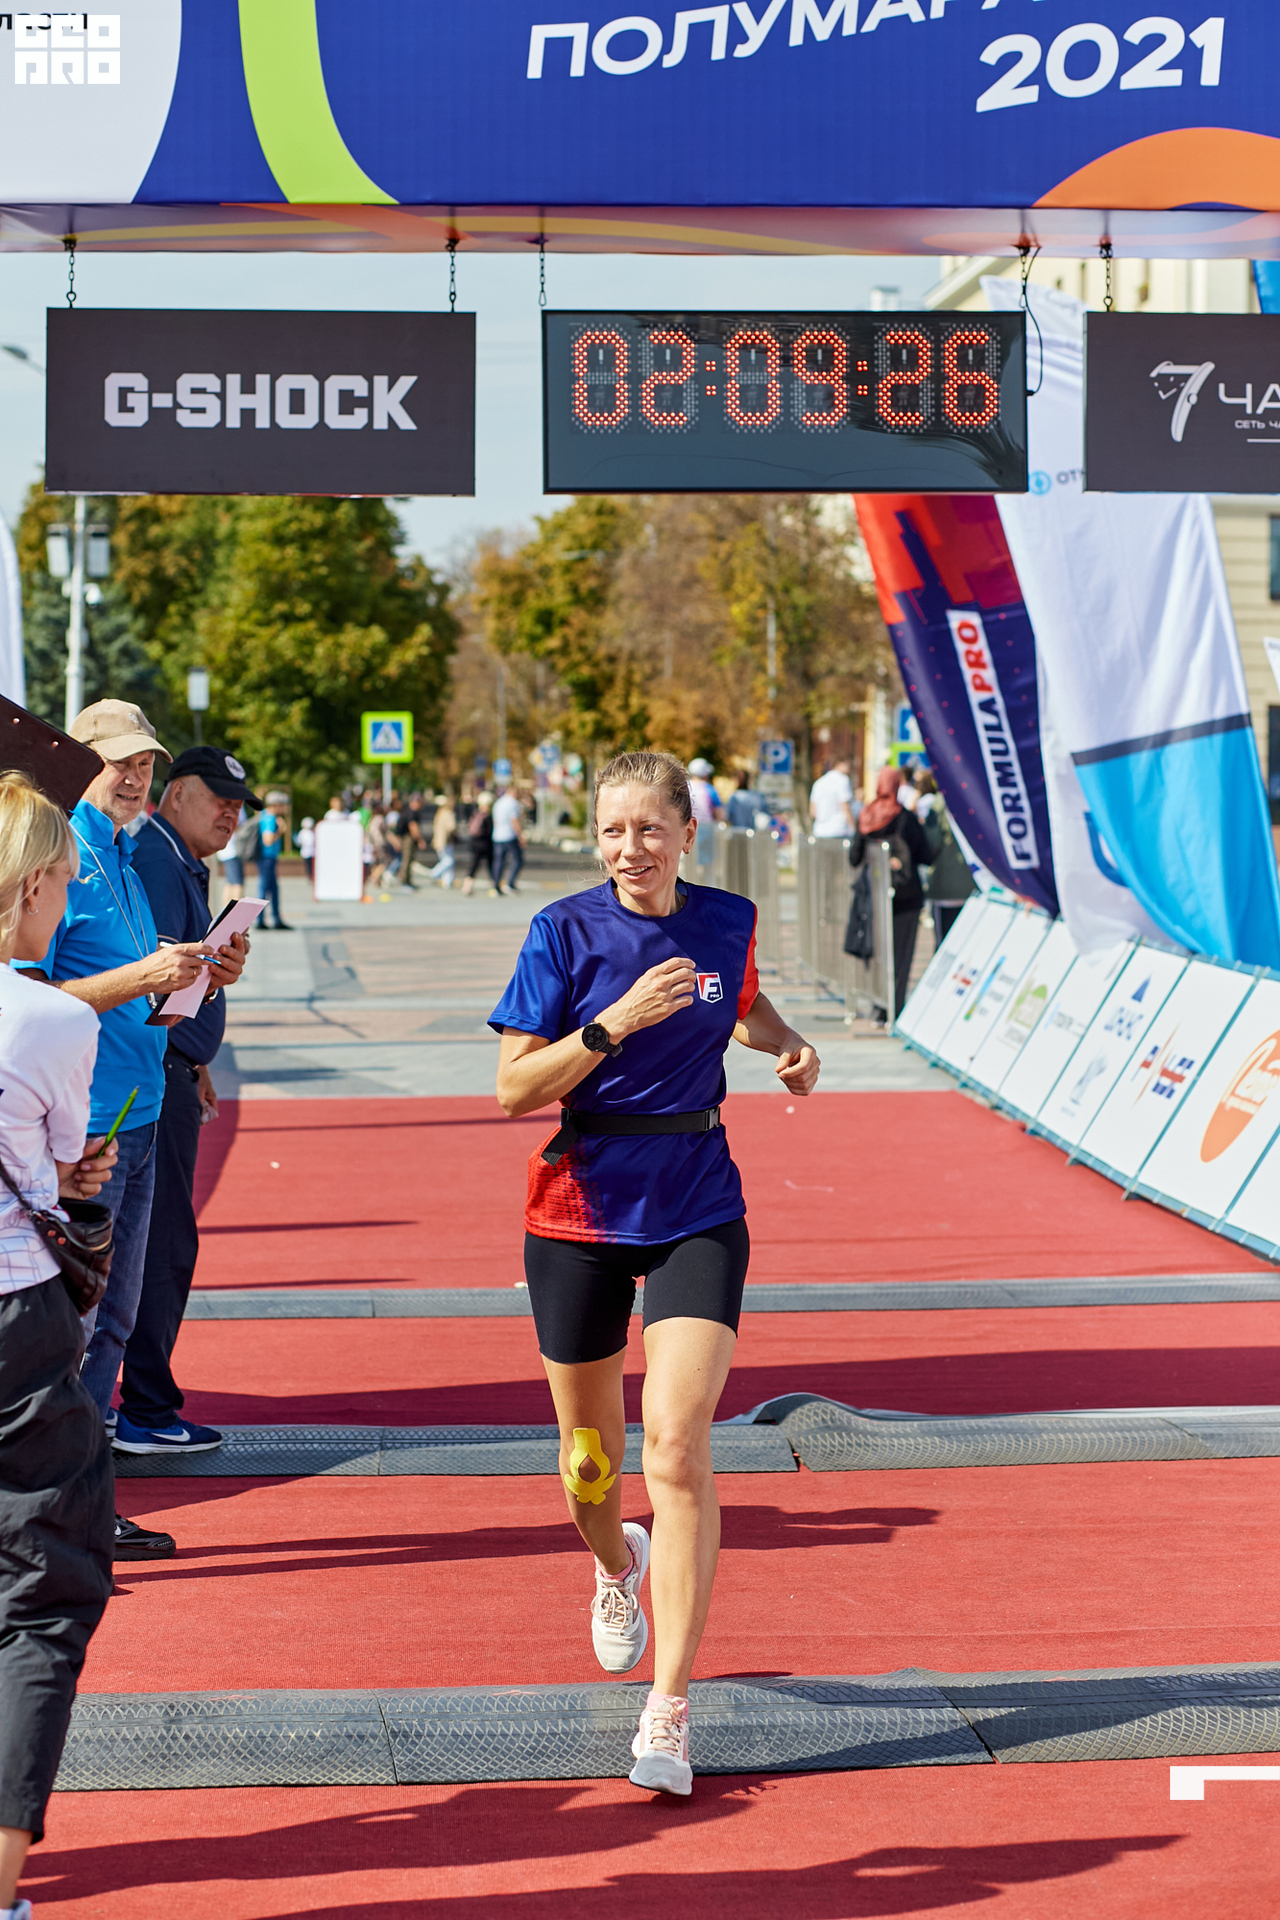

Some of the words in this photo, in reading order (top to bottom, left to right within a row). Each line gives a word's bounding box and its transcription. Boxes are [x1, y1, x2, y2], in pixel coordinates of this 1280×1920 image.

[526, 0, 1000, 80] ПОЛУМА
[975, 16, 1225, 113] 2021
[103, 371, 418, 431] G-SHOCK
[573, 330, 998, 426] 02:09:26
[1234, 419, 1266, 429] СЕТЬ
